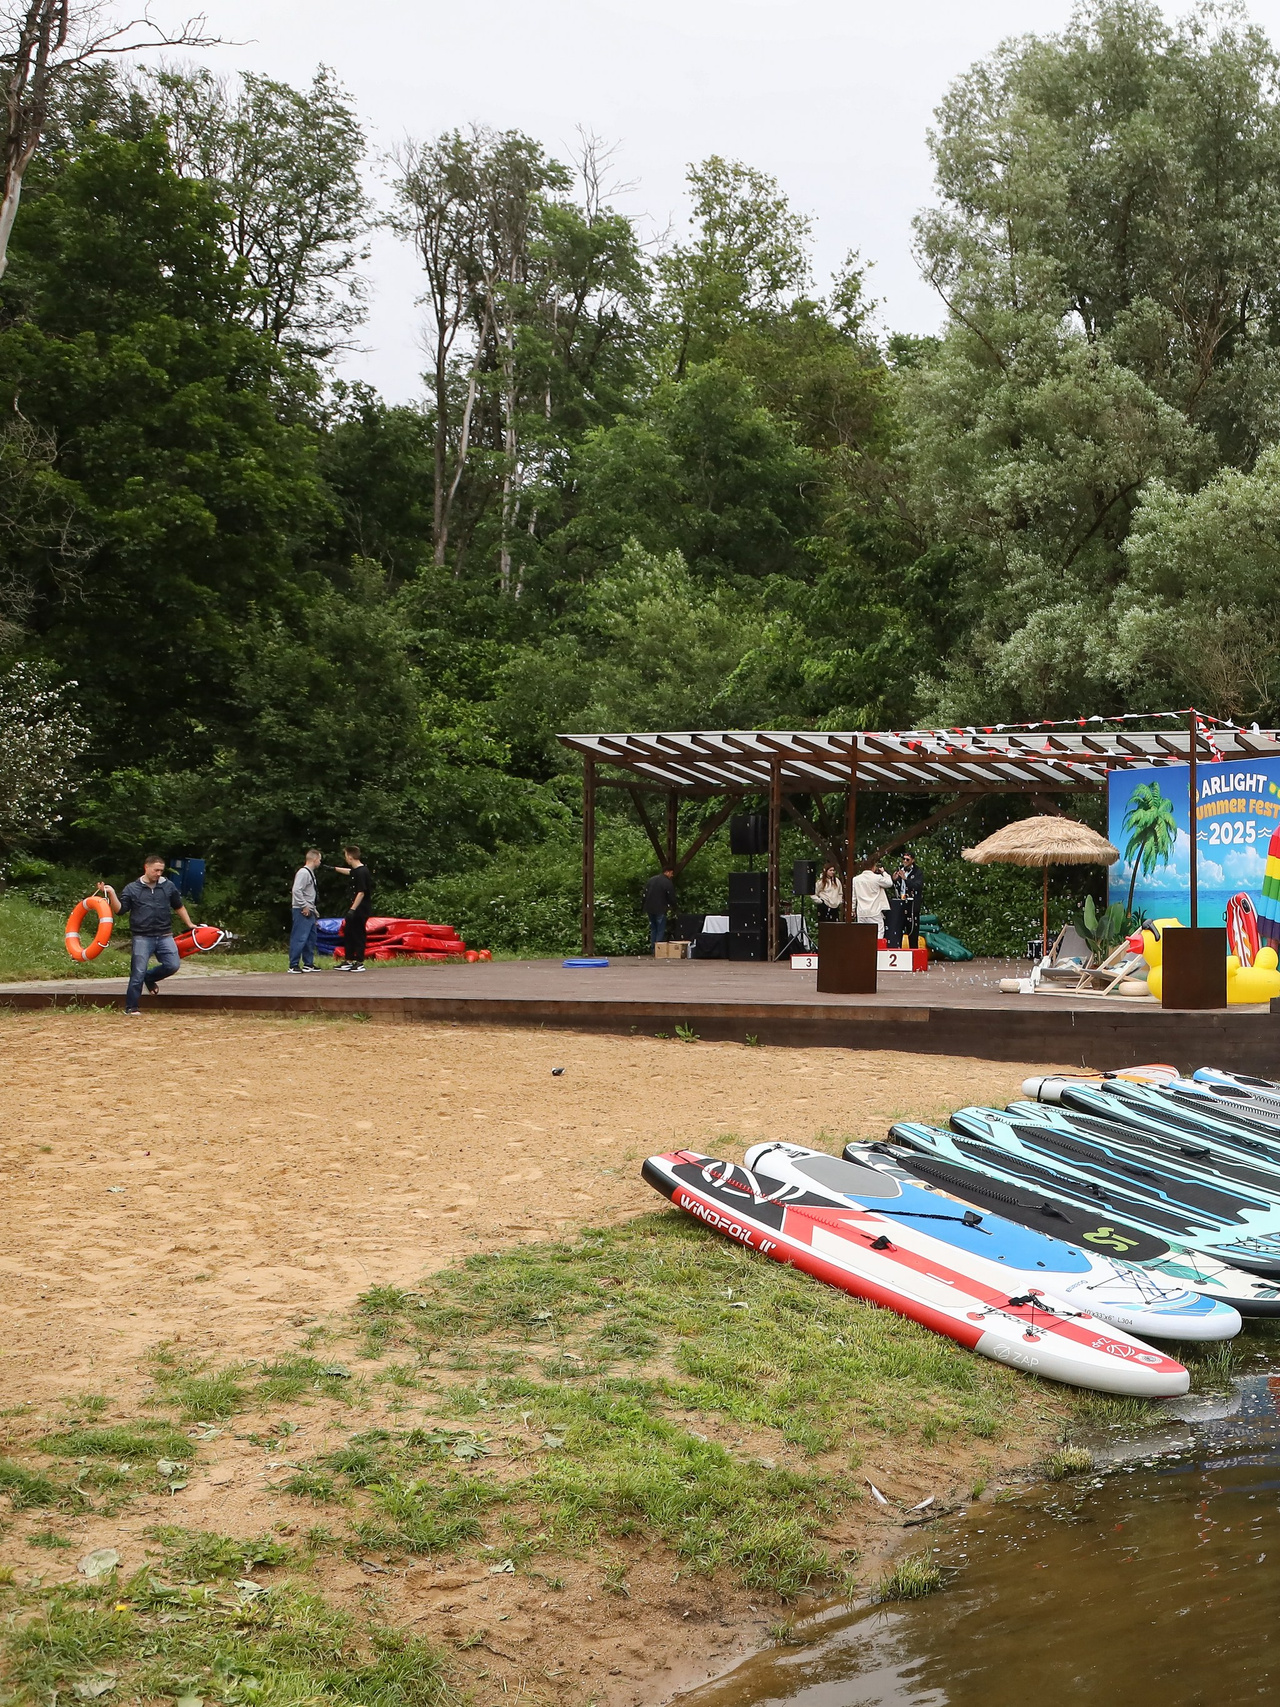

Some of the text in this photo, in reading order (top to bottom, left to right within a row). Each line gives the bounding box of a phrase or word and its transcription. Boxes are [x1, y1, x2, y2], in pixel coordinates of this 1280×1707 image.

[1201, 772, 1268, 799] ARLIGHT
[1208, 820, 1256, 845] 2025
[805, 958, 812, 968] 3
[888, 953, 898, 967] 2
[1012, 1351, 1040, 1367] ZAP
